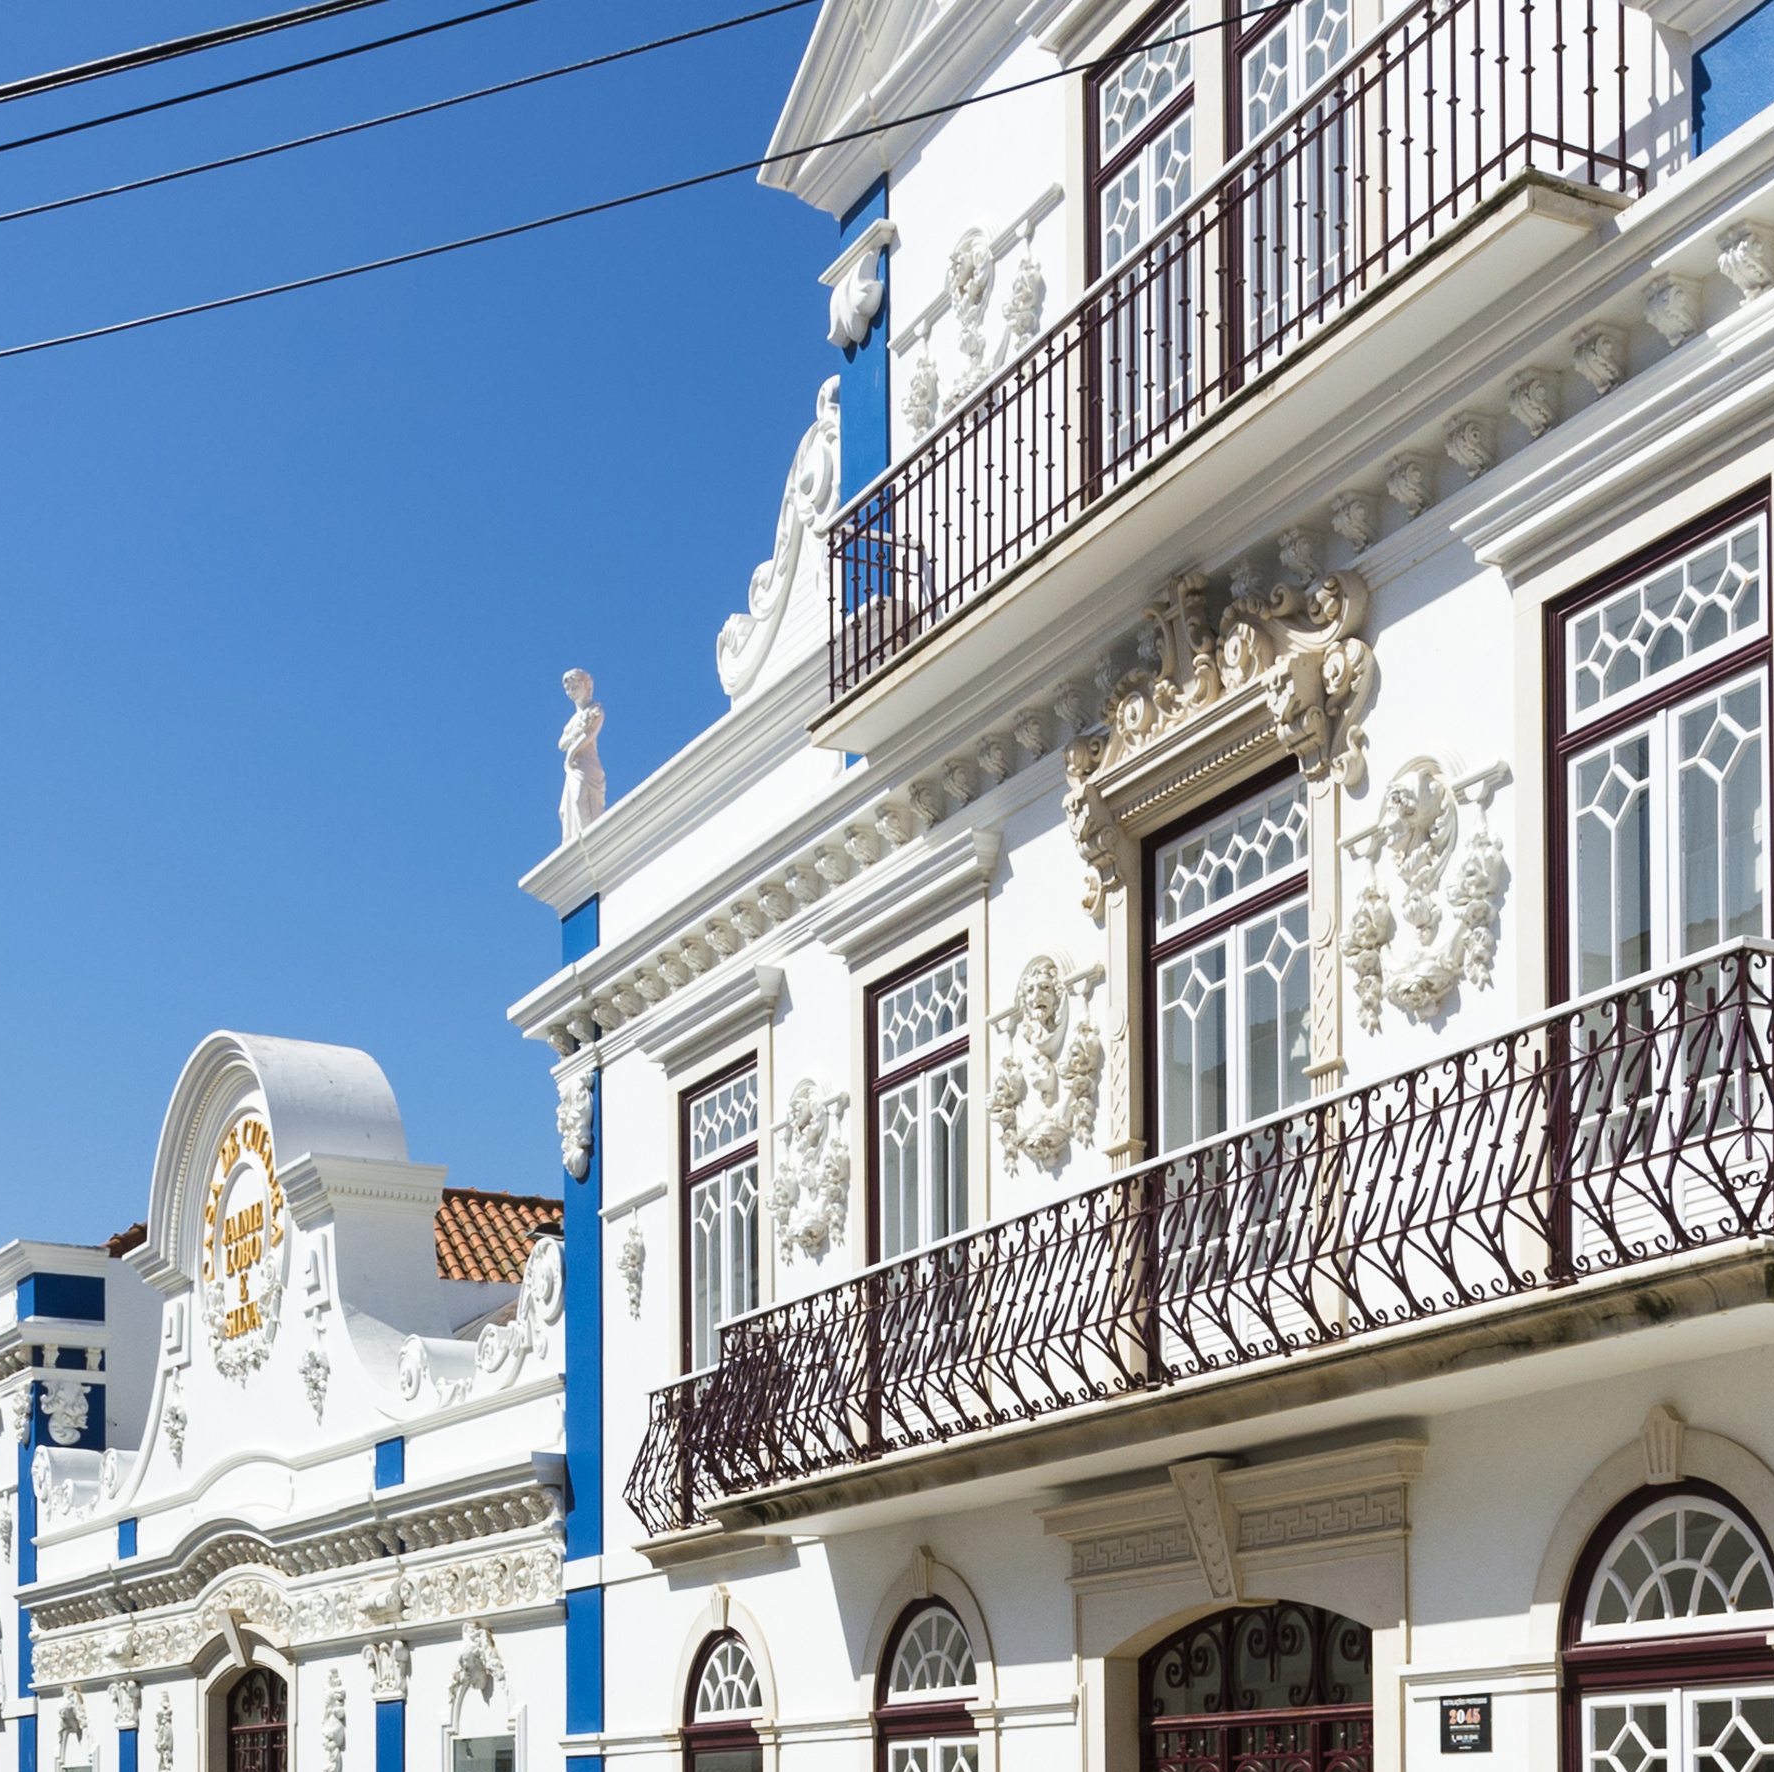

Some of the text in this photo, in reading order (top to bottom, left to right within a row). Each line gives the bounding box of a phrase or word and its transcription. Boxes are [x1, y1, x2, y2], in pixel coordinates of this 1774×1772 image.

[203, 1181, 224, 1283] CASA
[219, 1127, 240, 1179] DE
[221, 1200, 263, 1247] JAIME
[225, 1233, 262, 1277] LOBO
[239, 1272, 249, 1303] E
[225, 1300, 262, 1339] SILVA
